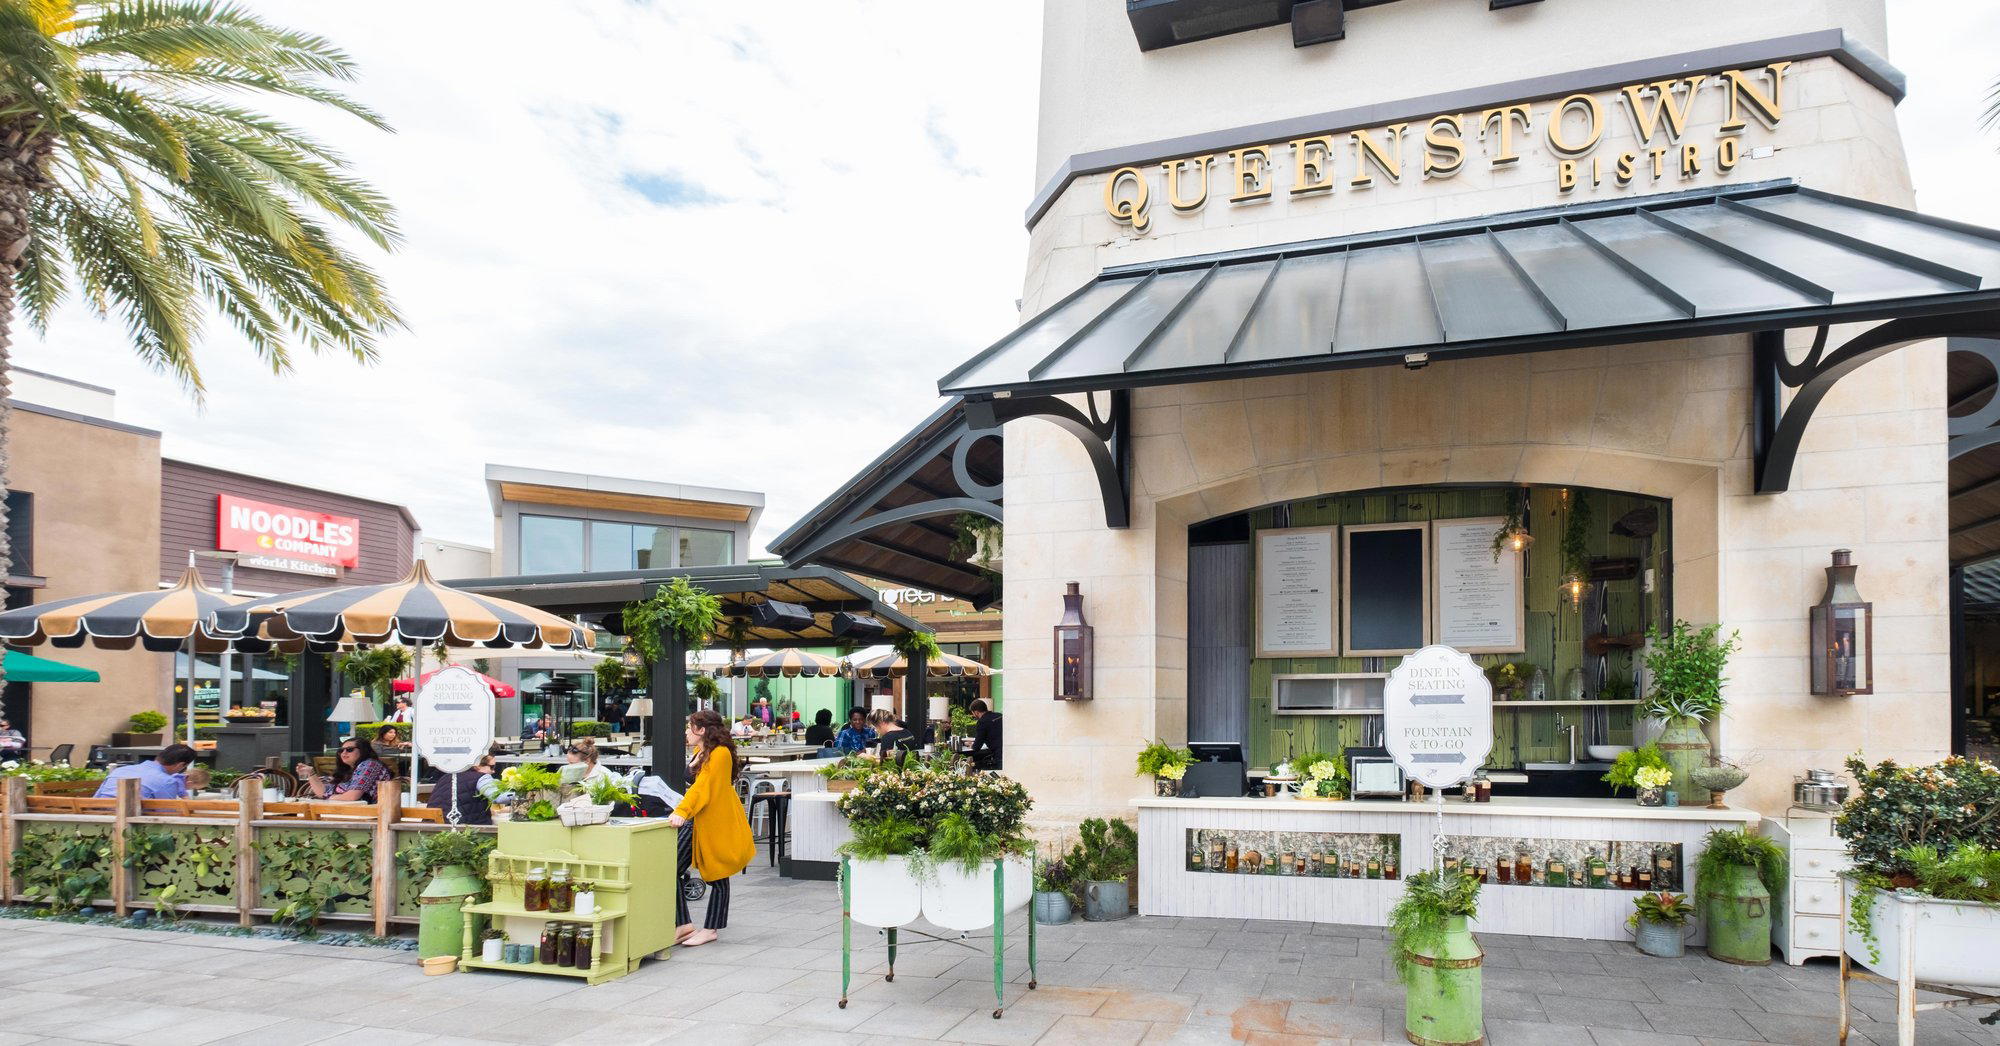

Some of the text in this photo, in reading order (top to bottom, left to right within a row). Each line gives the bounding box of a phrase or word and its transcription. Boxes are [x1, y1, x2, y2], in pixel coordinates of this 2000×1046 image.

[1104, 61, 1792, 231] QUEENSTOWN
[1559, 137, 1739, 193] BISTRO
[230, 505, 353, 546] NOODLES
[274, 538, 338, 558] COMPANY
[291, 560, 337, 576] Kitchen
[1409, 667, 1461, 678] DINE IN
[435, 683, 470, 691] DINE IN
[1408, 679, 1465, 690] SEATING
[433, 692, 473, 701] SEATING
[429, 727, 477, 736] FOUNTAIN
[1404, 727, 1473, 738] FOUNTAIN
[1409, 739, 1464, 750] & TO-GO
